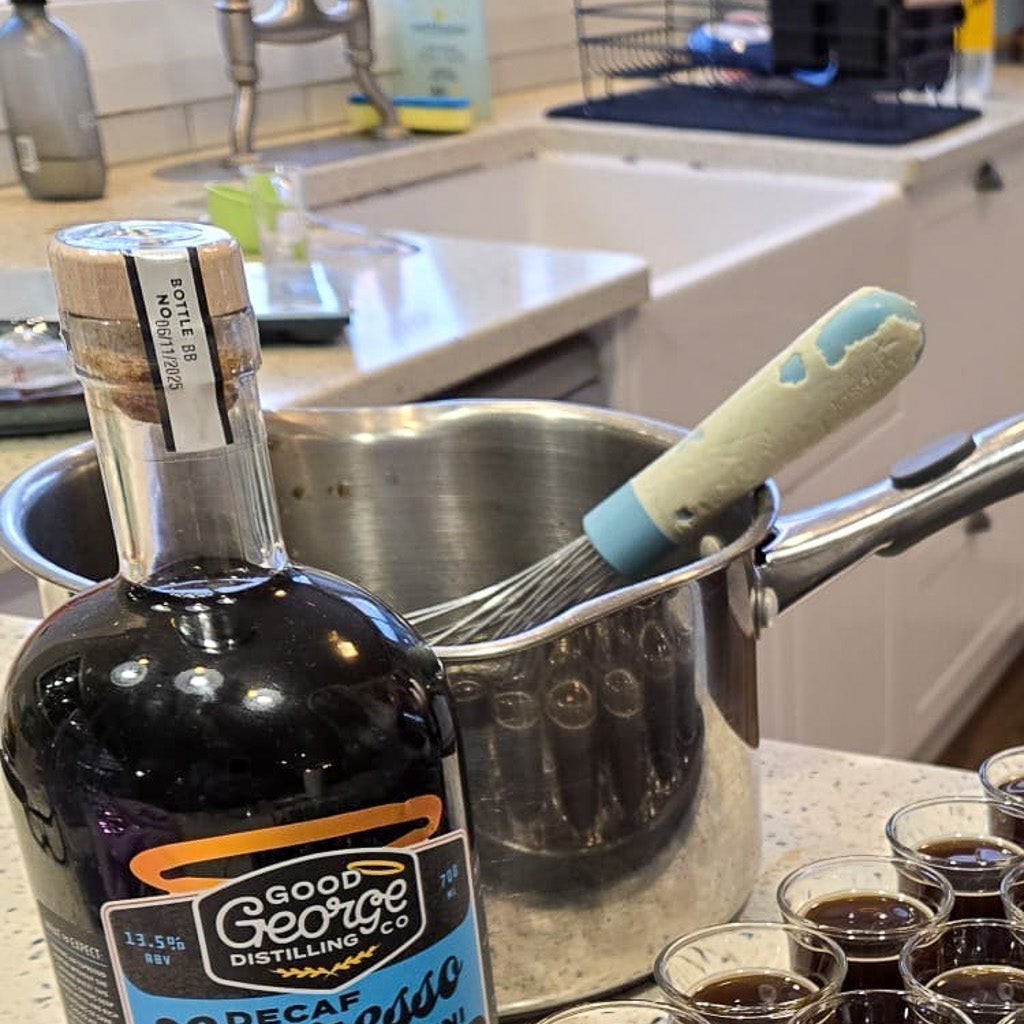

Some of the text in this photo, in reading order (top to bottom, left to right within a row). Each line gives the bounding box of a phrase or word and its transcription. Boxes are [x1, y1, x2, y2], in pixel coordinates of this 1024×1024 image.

[155, 294, 183, 391] NO 06/11/2025
[170, 278, 197, 362] BOTTLE BB
[265, 869, 361, 905] GOOD
[215, 878, 408, 949] George
[124, 931, 186, 950] 13.5%
[144, 952, 171, 966] ABV
[230, 915, 409, 967] DISTILLING CO
